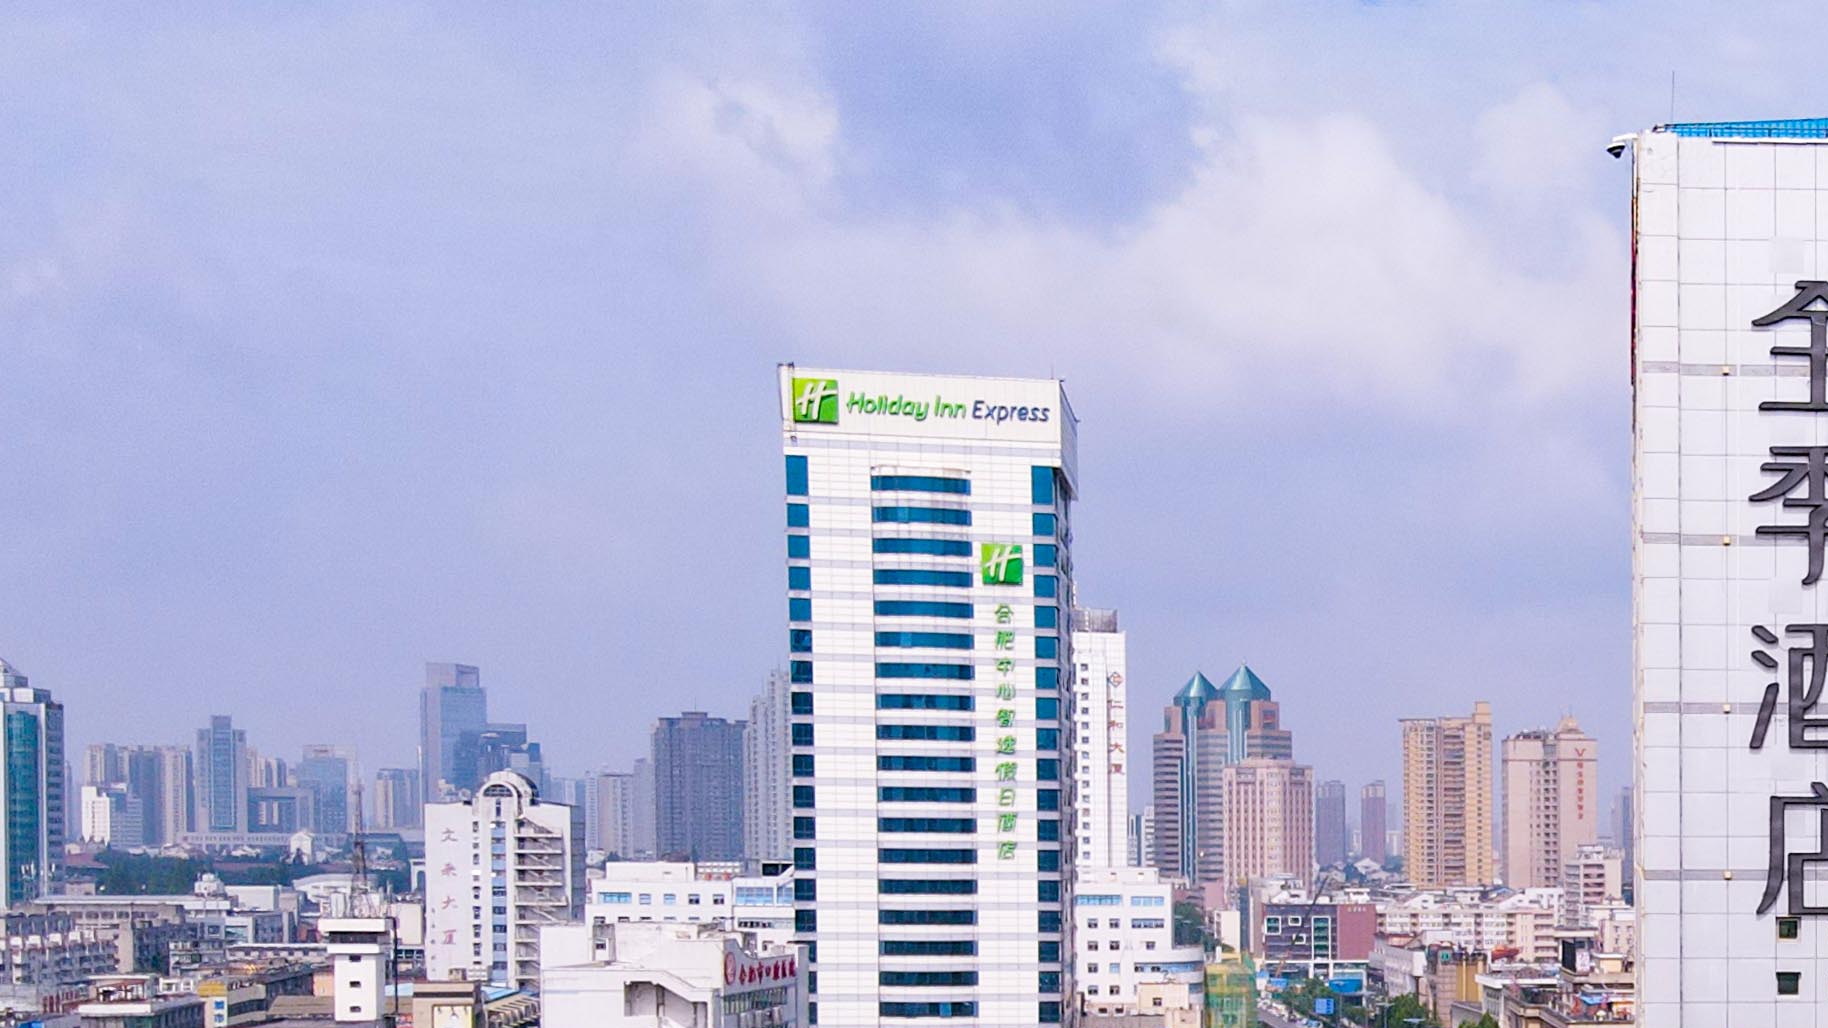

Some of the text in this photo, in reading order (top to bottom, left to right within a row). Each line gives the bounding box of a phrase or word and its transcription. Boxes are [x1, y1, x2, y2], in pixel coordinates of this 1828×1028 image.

[846, 391, 1050, 425] Holiday Inn Express
